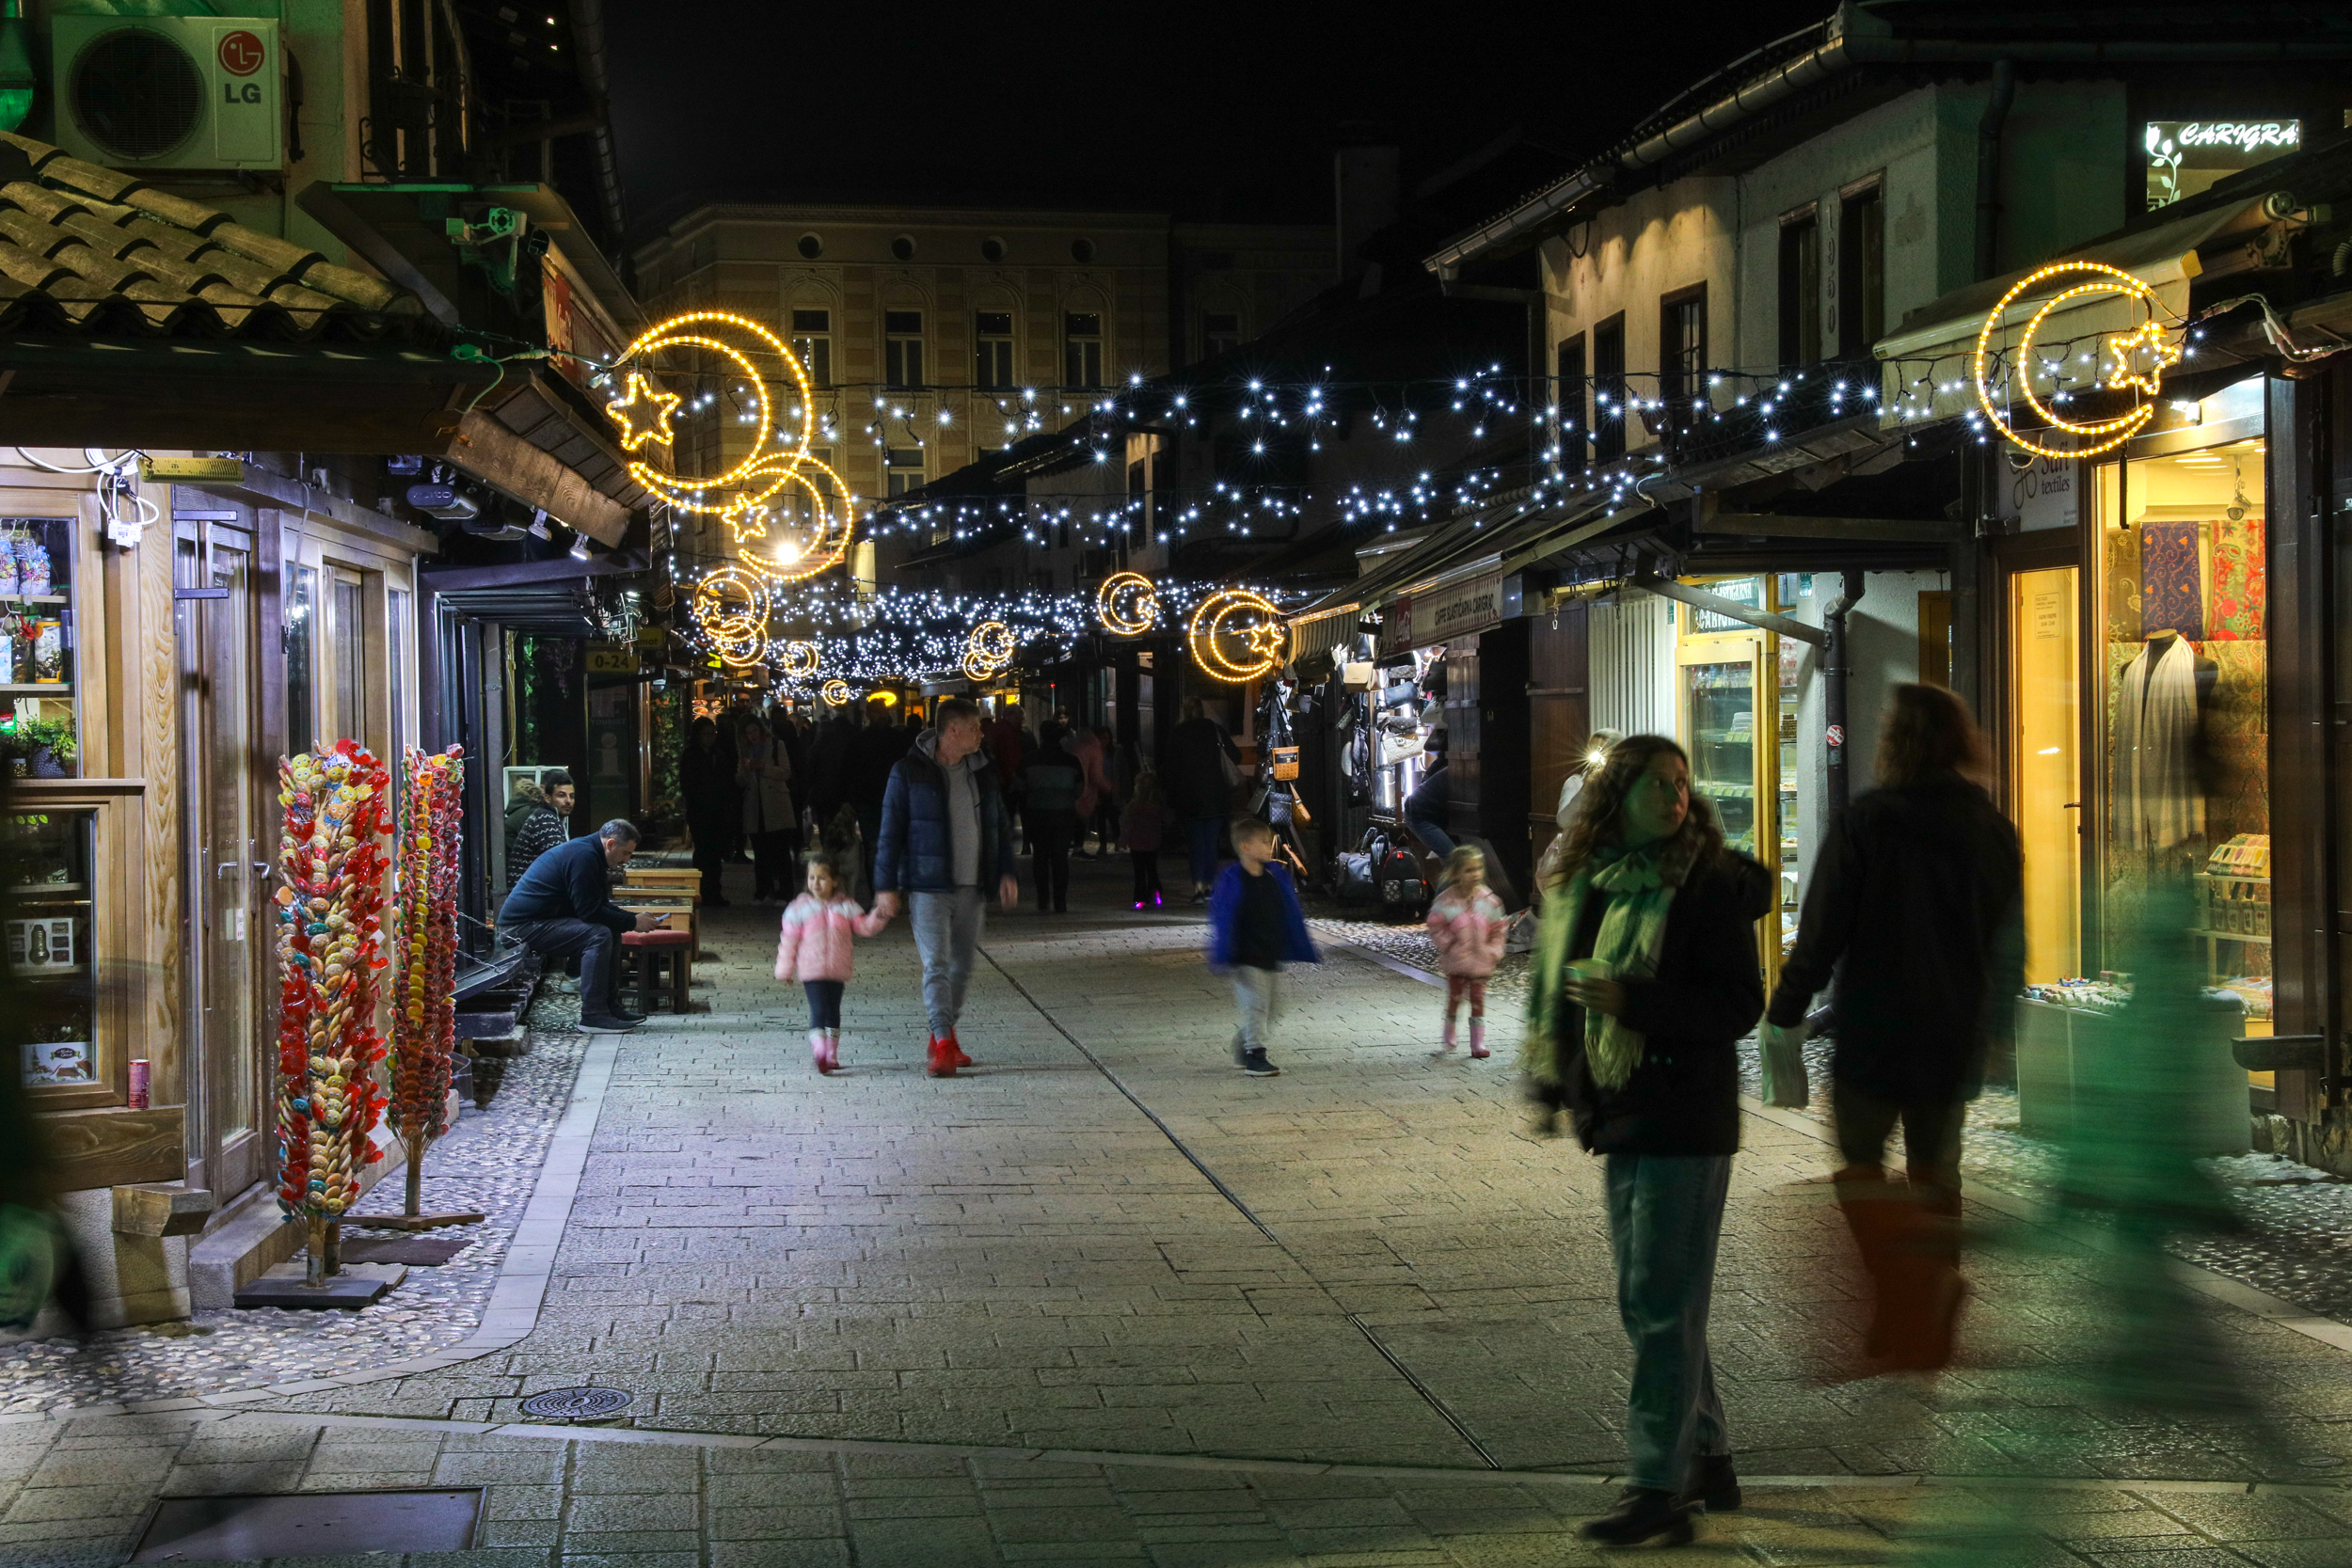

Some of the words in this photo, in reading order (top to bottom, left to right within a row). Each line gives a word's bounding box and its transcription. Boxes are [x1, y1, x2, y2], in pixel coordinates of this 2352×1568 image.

[224, 82, 262, 104] LG
[2179, 122, 2299, 152] CARIGRA
[2041, 475, 2070, 495] textiles
[1698, 608, 1747, 629] CARIG
[595, 654, 629, 669] 0-24
